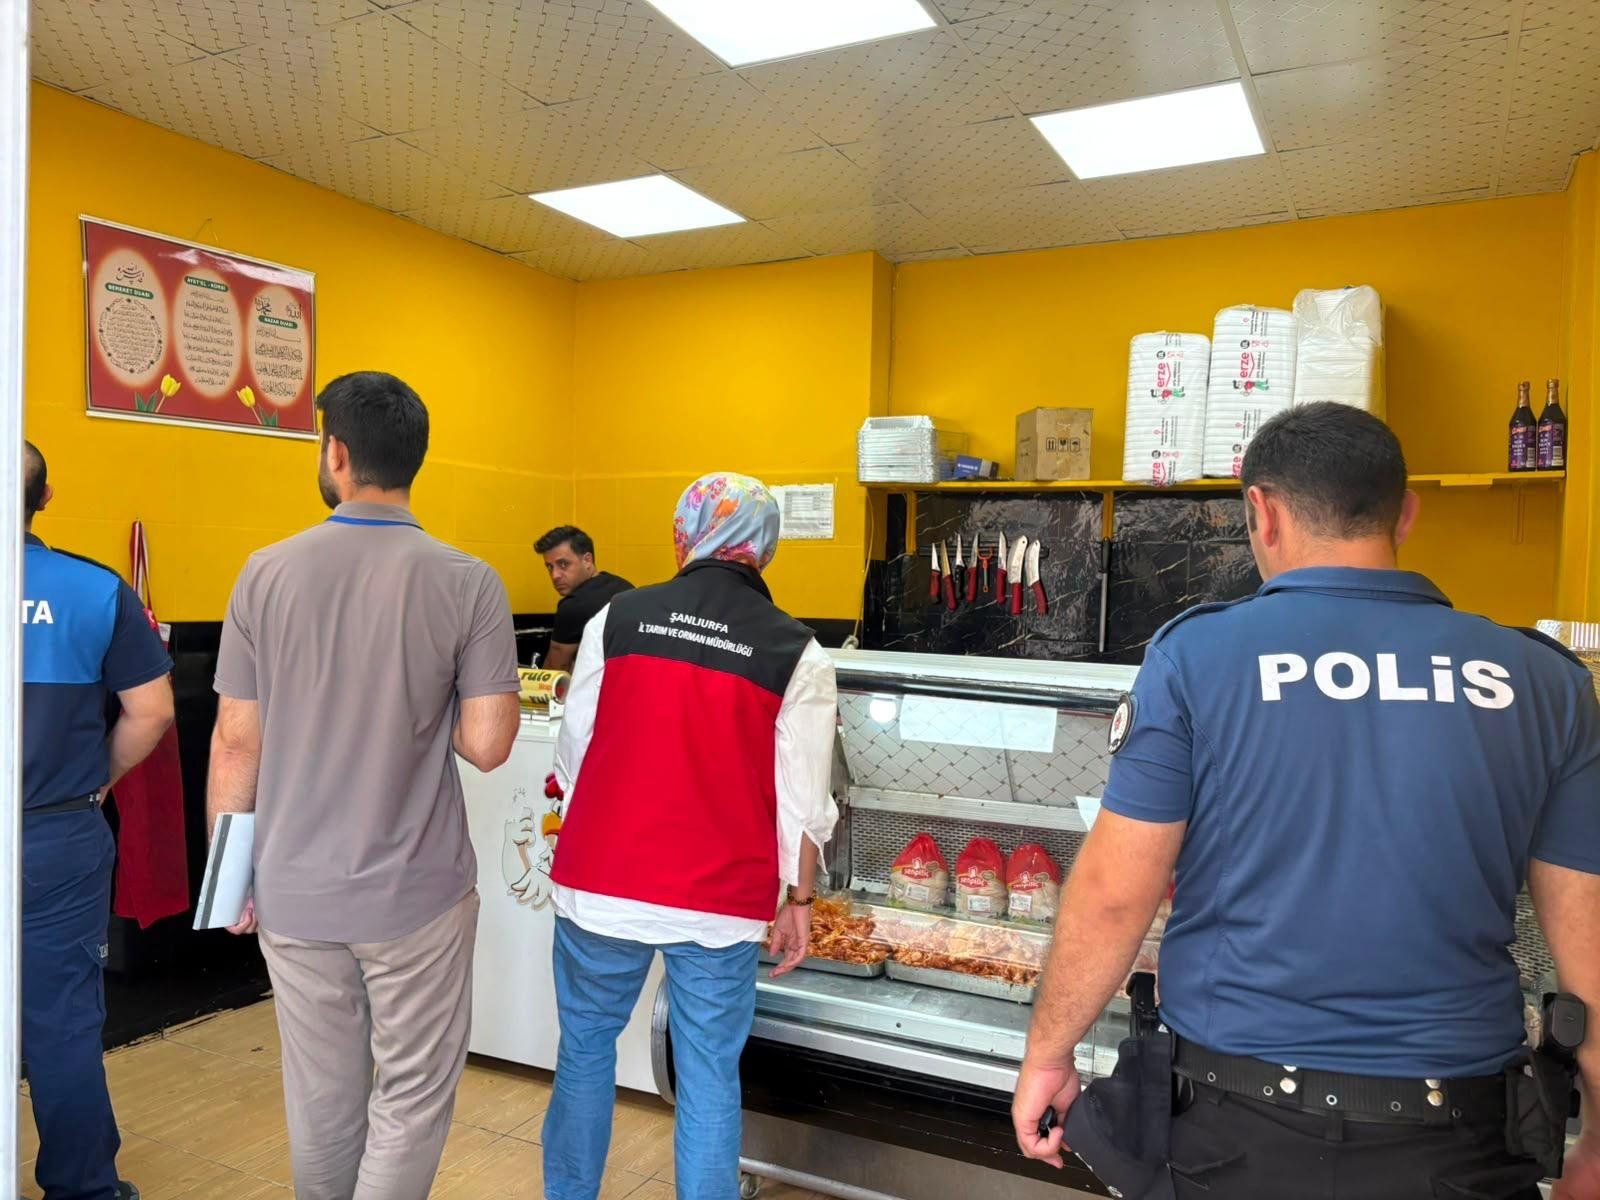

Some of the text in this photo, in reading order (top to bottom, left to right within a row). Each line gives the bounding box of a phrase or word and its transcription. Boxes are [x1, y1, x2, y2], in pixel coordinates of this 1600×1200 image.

[1157, 362, 1166, 388] erze
[1239, 352, 1249, 378] erze
[669, 612, 728, 634] ŞANLIURFA
[638, 621, 754, 658] İL TARIM VE ORMAN MÜDÜRLÜĞÜ
